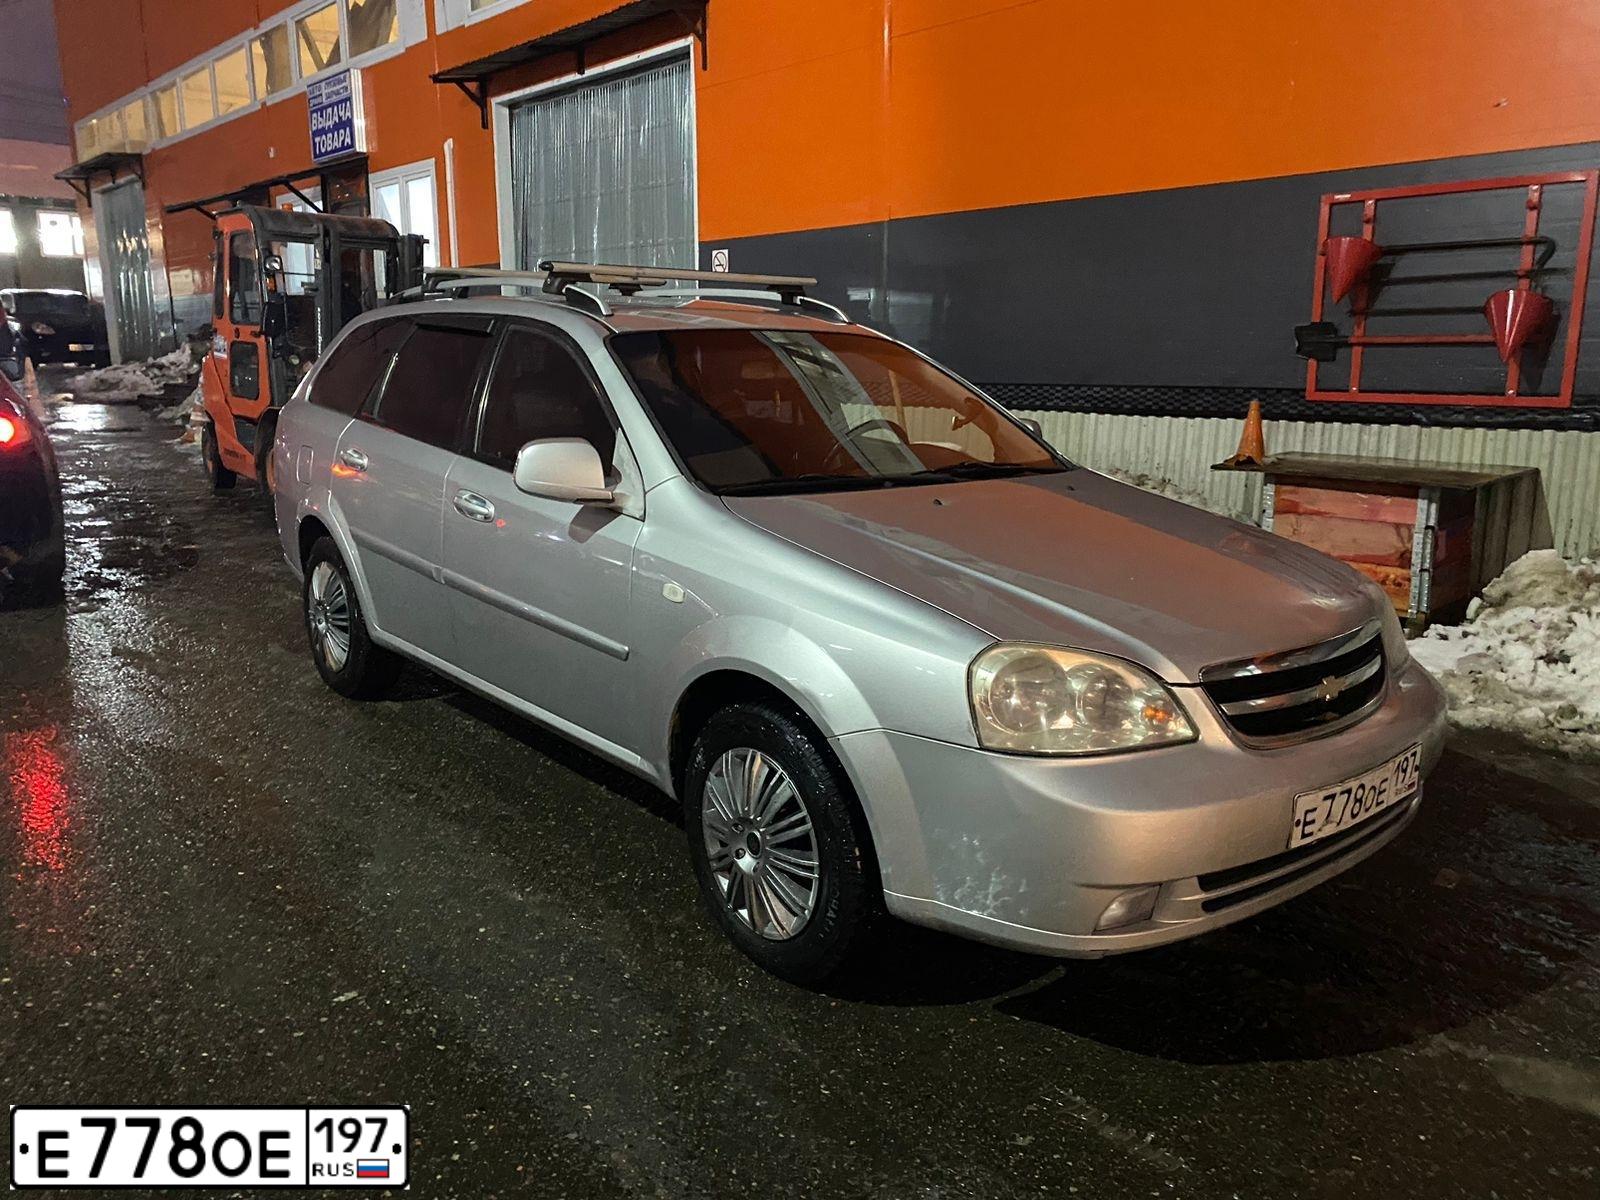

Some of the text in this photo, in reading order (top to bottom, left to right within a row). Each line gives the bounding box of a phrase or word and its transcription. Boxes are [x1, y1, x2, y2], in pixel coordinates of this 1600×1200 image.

[311, 101, 352, 131] ВЫДАЧА
[314, 127, 352, 155] ТОВАРА
[1394, 750, 1417, 787] 197
